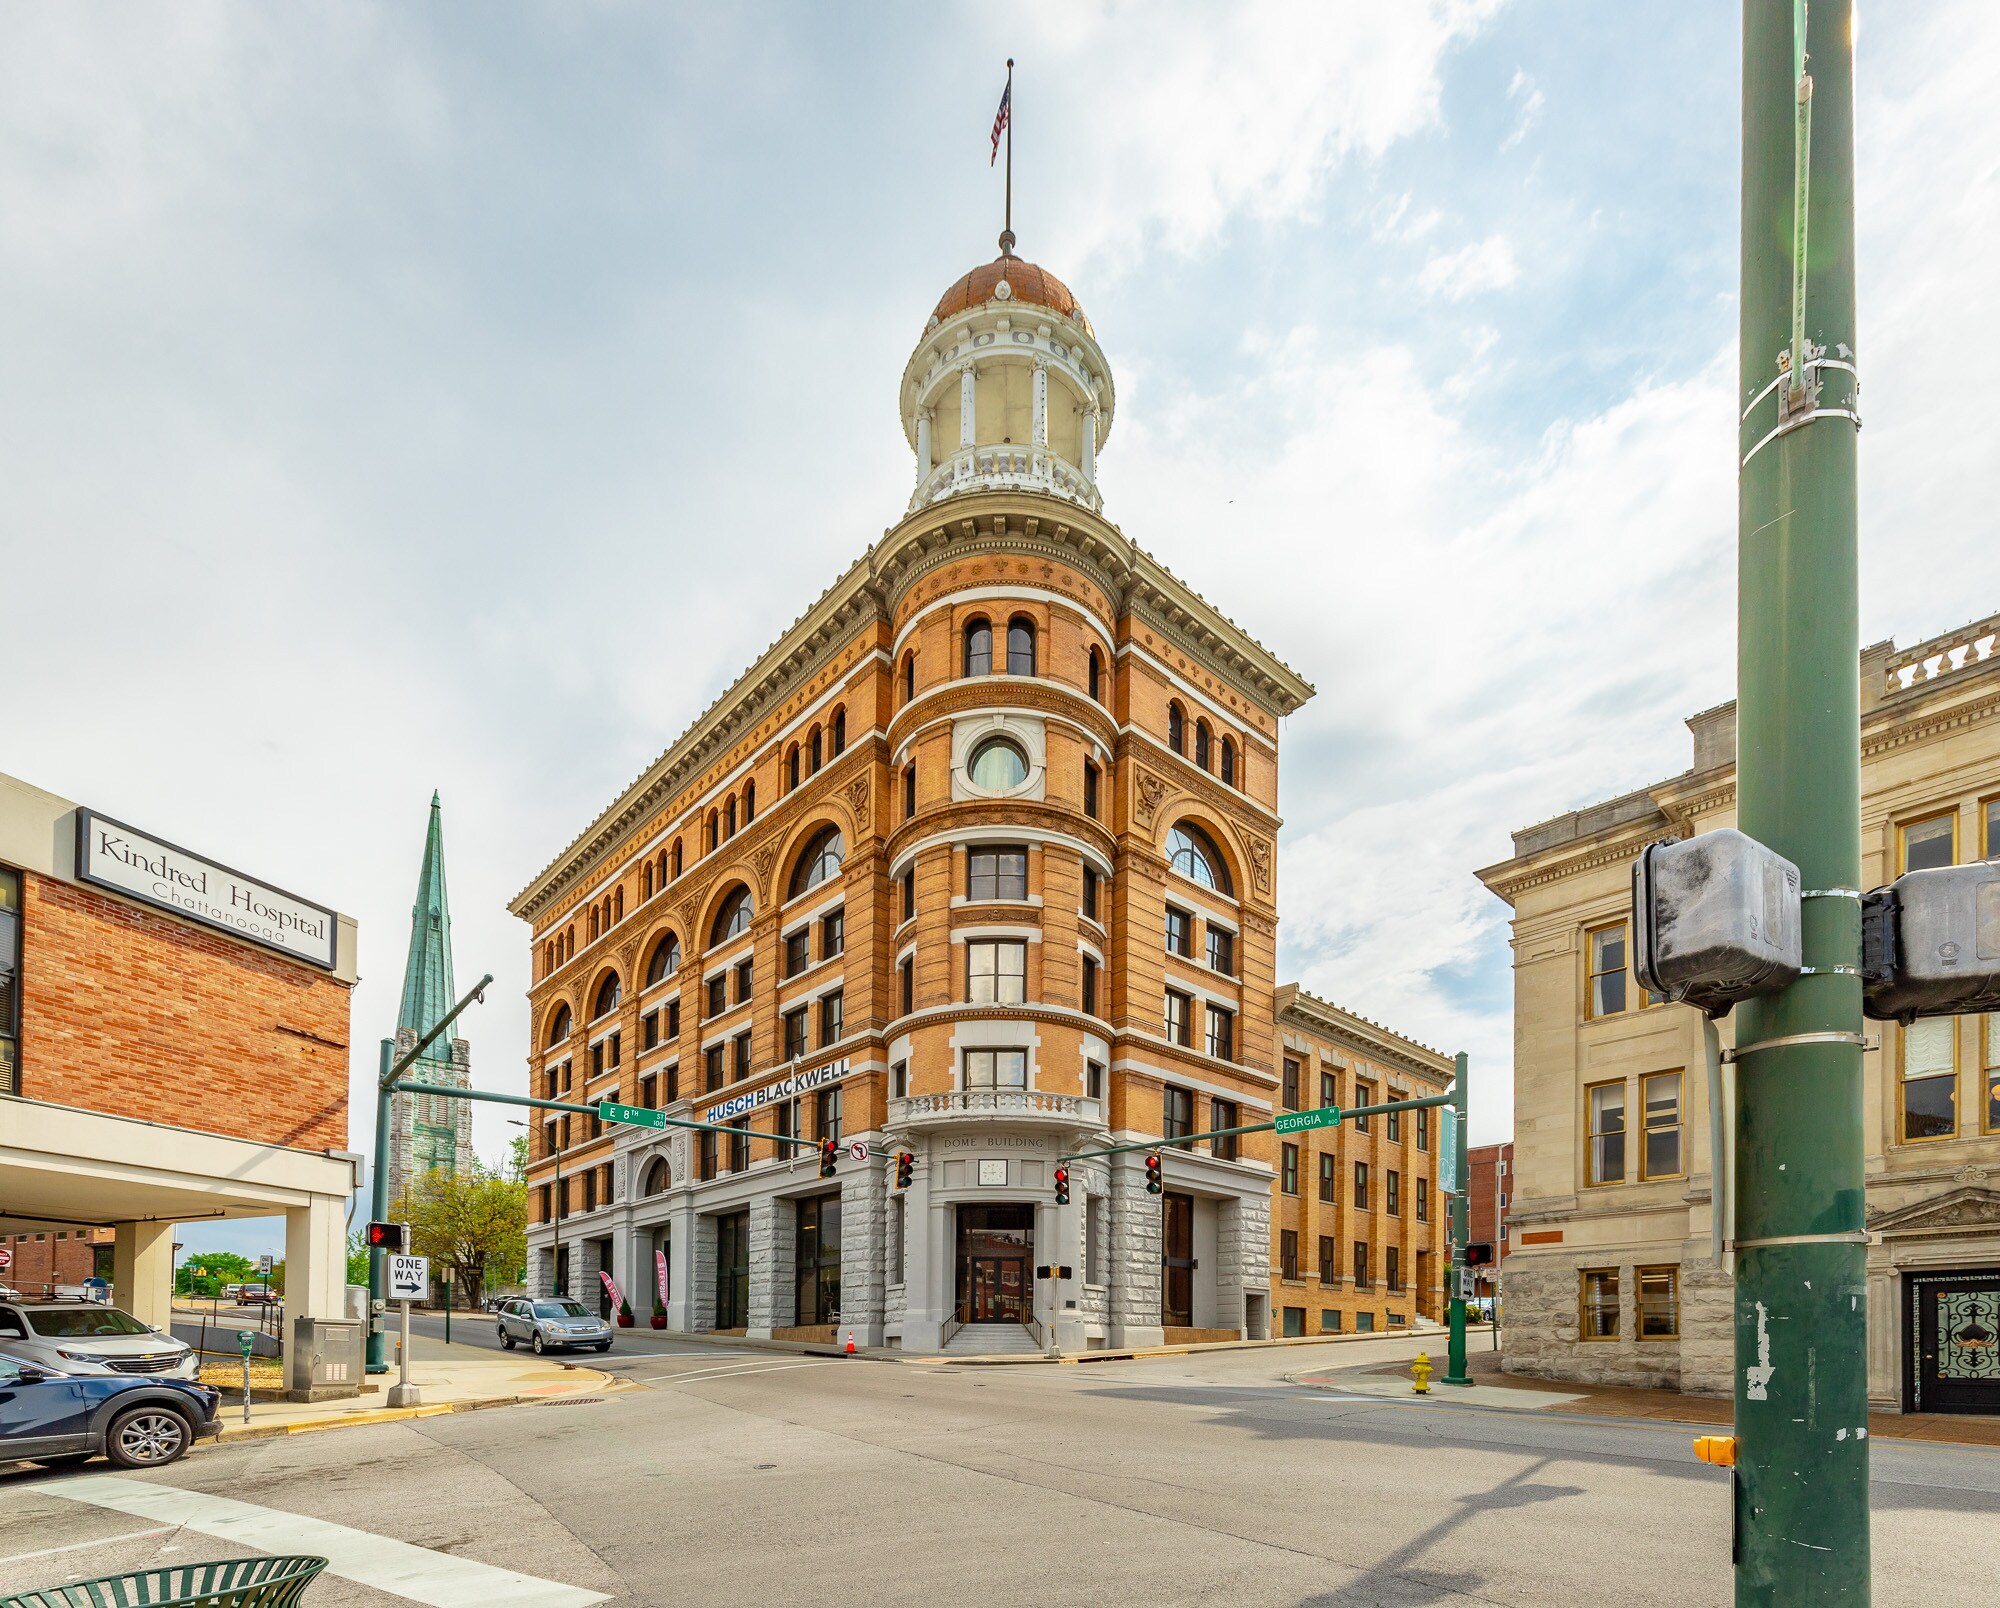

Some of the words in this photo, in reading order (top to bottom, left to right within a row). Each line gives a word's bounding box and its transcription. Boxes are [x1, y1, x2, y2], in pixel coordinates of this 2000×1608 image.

[98, 830, 208, 895] Kindred
[229, 883, 325, 940] Hospital
[151, 881, 285, 943] Chattanooga
[706, 1093, 754, 1123] HUSCH
[756, 1058, 850, 1104] BLACKWELL
[609, 1107, 616, 1118] E
[623, 1109, 639, 1120] 8TH
[652, 1120, 664, 1128] 100
[1276, 1114, 1322, 1130] GEORGIA
[944, 1138, 977, 1148] DOME
[987, 1137, 1044, 1148] BUILDING
[396, 1258, 422, 1270] ONE
[394, 1270, 424, 1282] WAY
[1464, 1268, 1473, 1279] ONE
[1463, 1278, 1473, 1288] WAY
